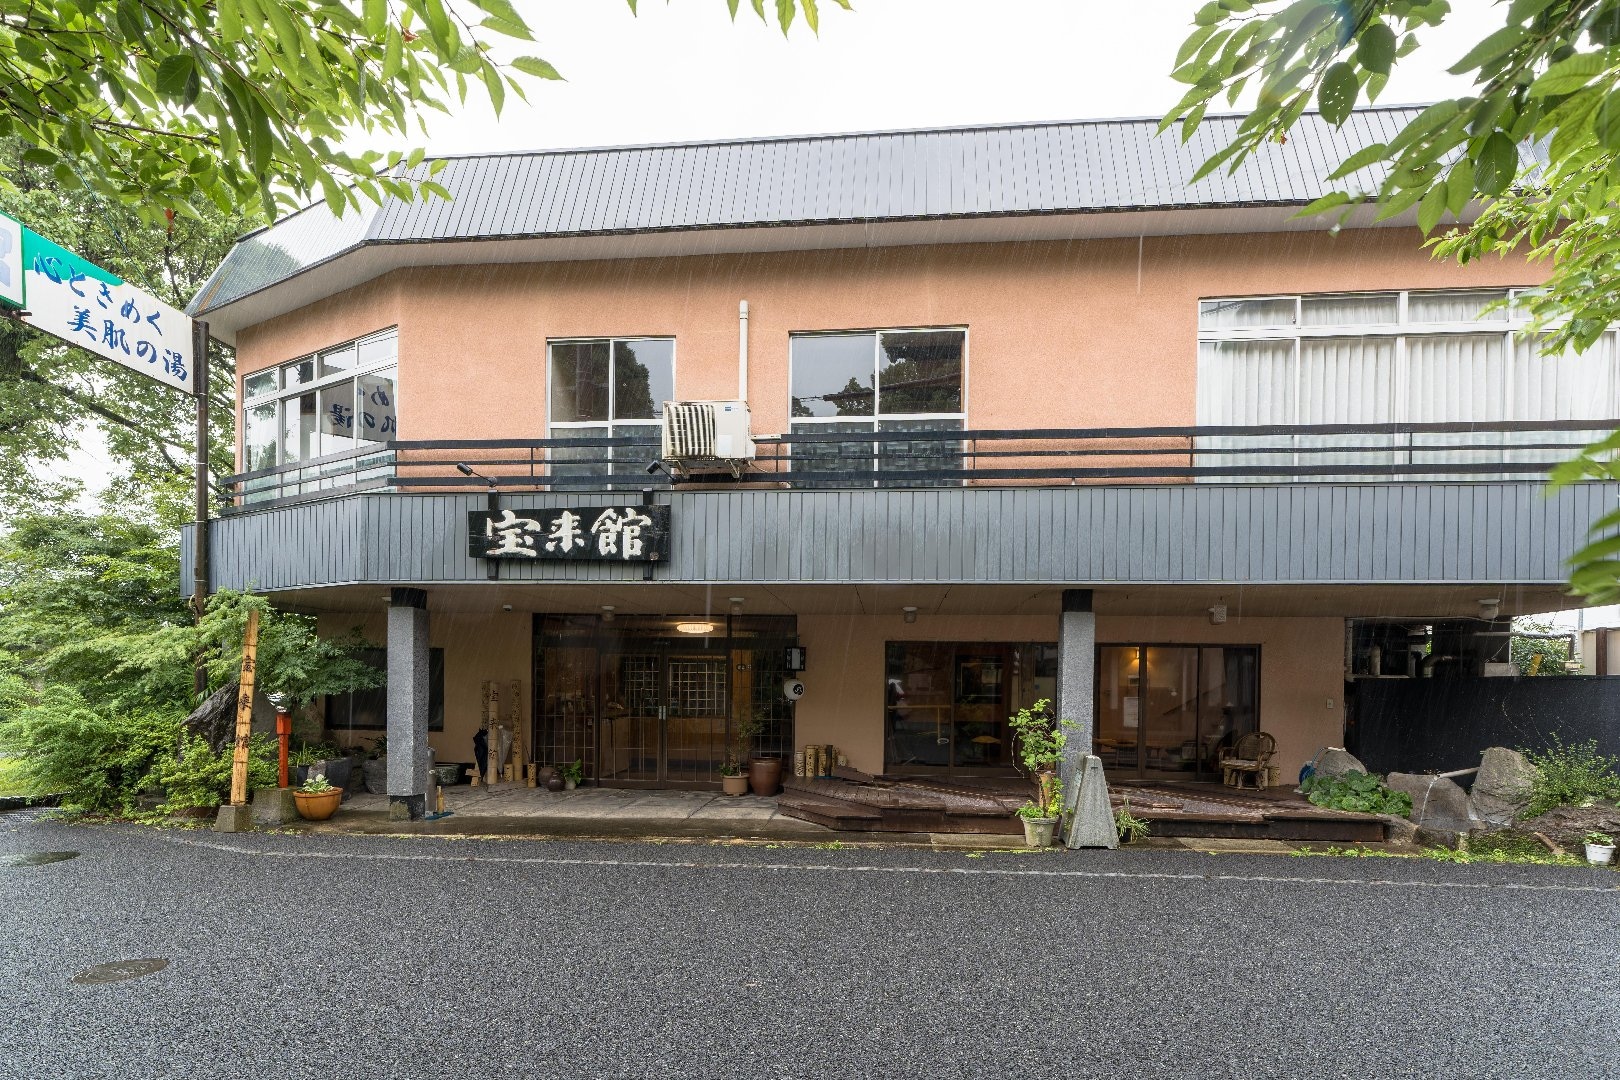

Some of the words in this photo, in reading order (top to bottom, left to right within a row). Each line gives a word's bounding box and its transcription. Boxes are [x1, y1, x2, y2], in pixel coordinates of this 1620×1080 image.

[34, 252, 162, 336] 心ときめく
[67, 305, 188, 381] 美肌の湯
[486, 508, 652, 560] 宝来館
